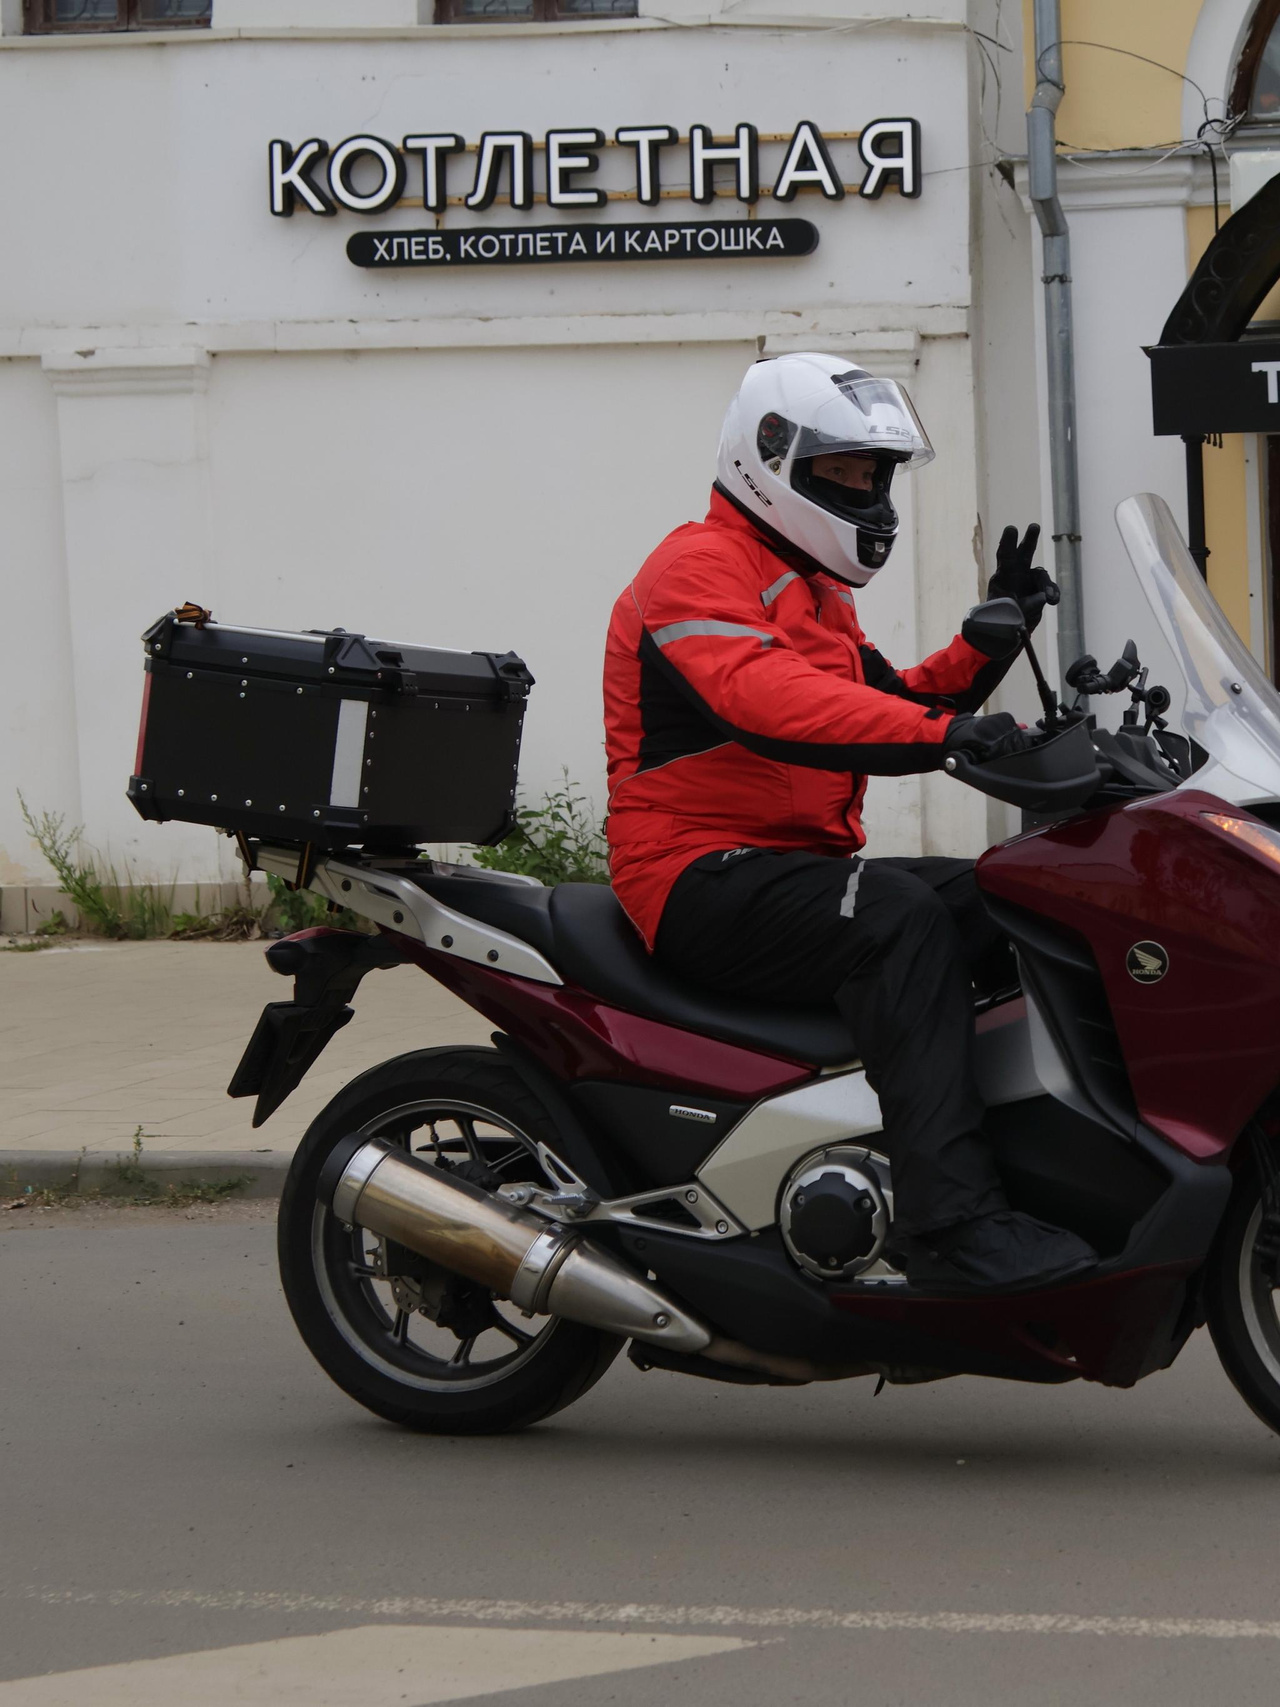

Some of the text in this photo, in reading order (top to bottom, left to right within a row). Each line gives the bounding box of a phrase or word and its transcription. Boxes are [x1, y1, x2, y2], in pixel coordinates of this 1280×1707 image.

[269, 117, 922, 217] КОТЛЕТНАЯ
[373, 226, 785, 262] ХЛЕБ, КОТЛЕТА И КАРТОШКА
[868, 424, 911, 439] LS2
[733, 459, 773, 508] LS2
[1132, 968, 1163, 976] HONDA
[674, 1108, 711, 1121] HONDA
